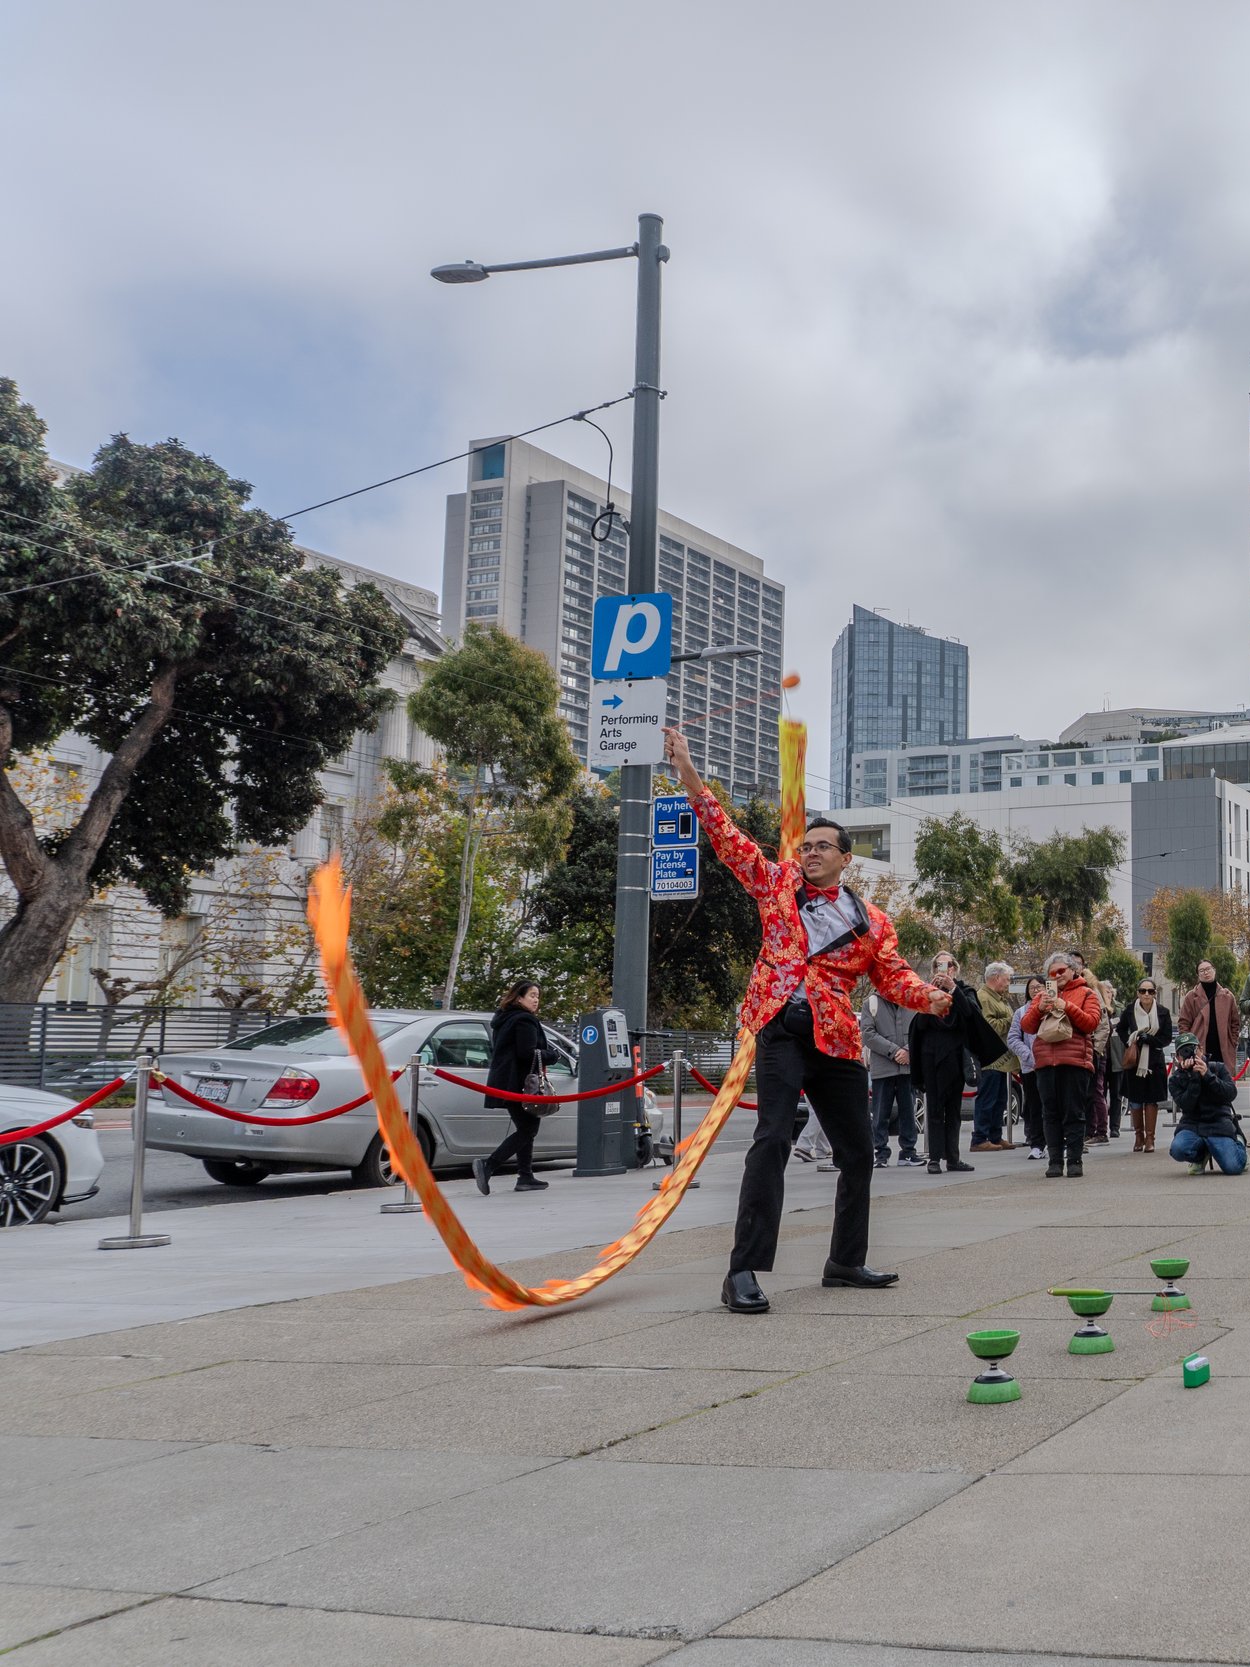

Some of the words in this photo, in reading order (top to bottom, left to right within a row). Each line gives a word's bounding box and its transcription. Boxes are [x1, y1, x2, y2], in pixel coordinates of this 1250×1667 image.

[601, 713, 658, 726] Performing
[600, 728, 622, 738] Arts
[600, 740, 637, 752] Garage
[656, 802, 673, 813] Pay
[655, 852, 671, 862] Pay
[673, 850, 684, 861] by
[655, 860, 686, 870] License
[655, 870, 677, 878] Plate
[656, 881, 693, 890] 70104003
[587, 1029, 595, 1041] P
